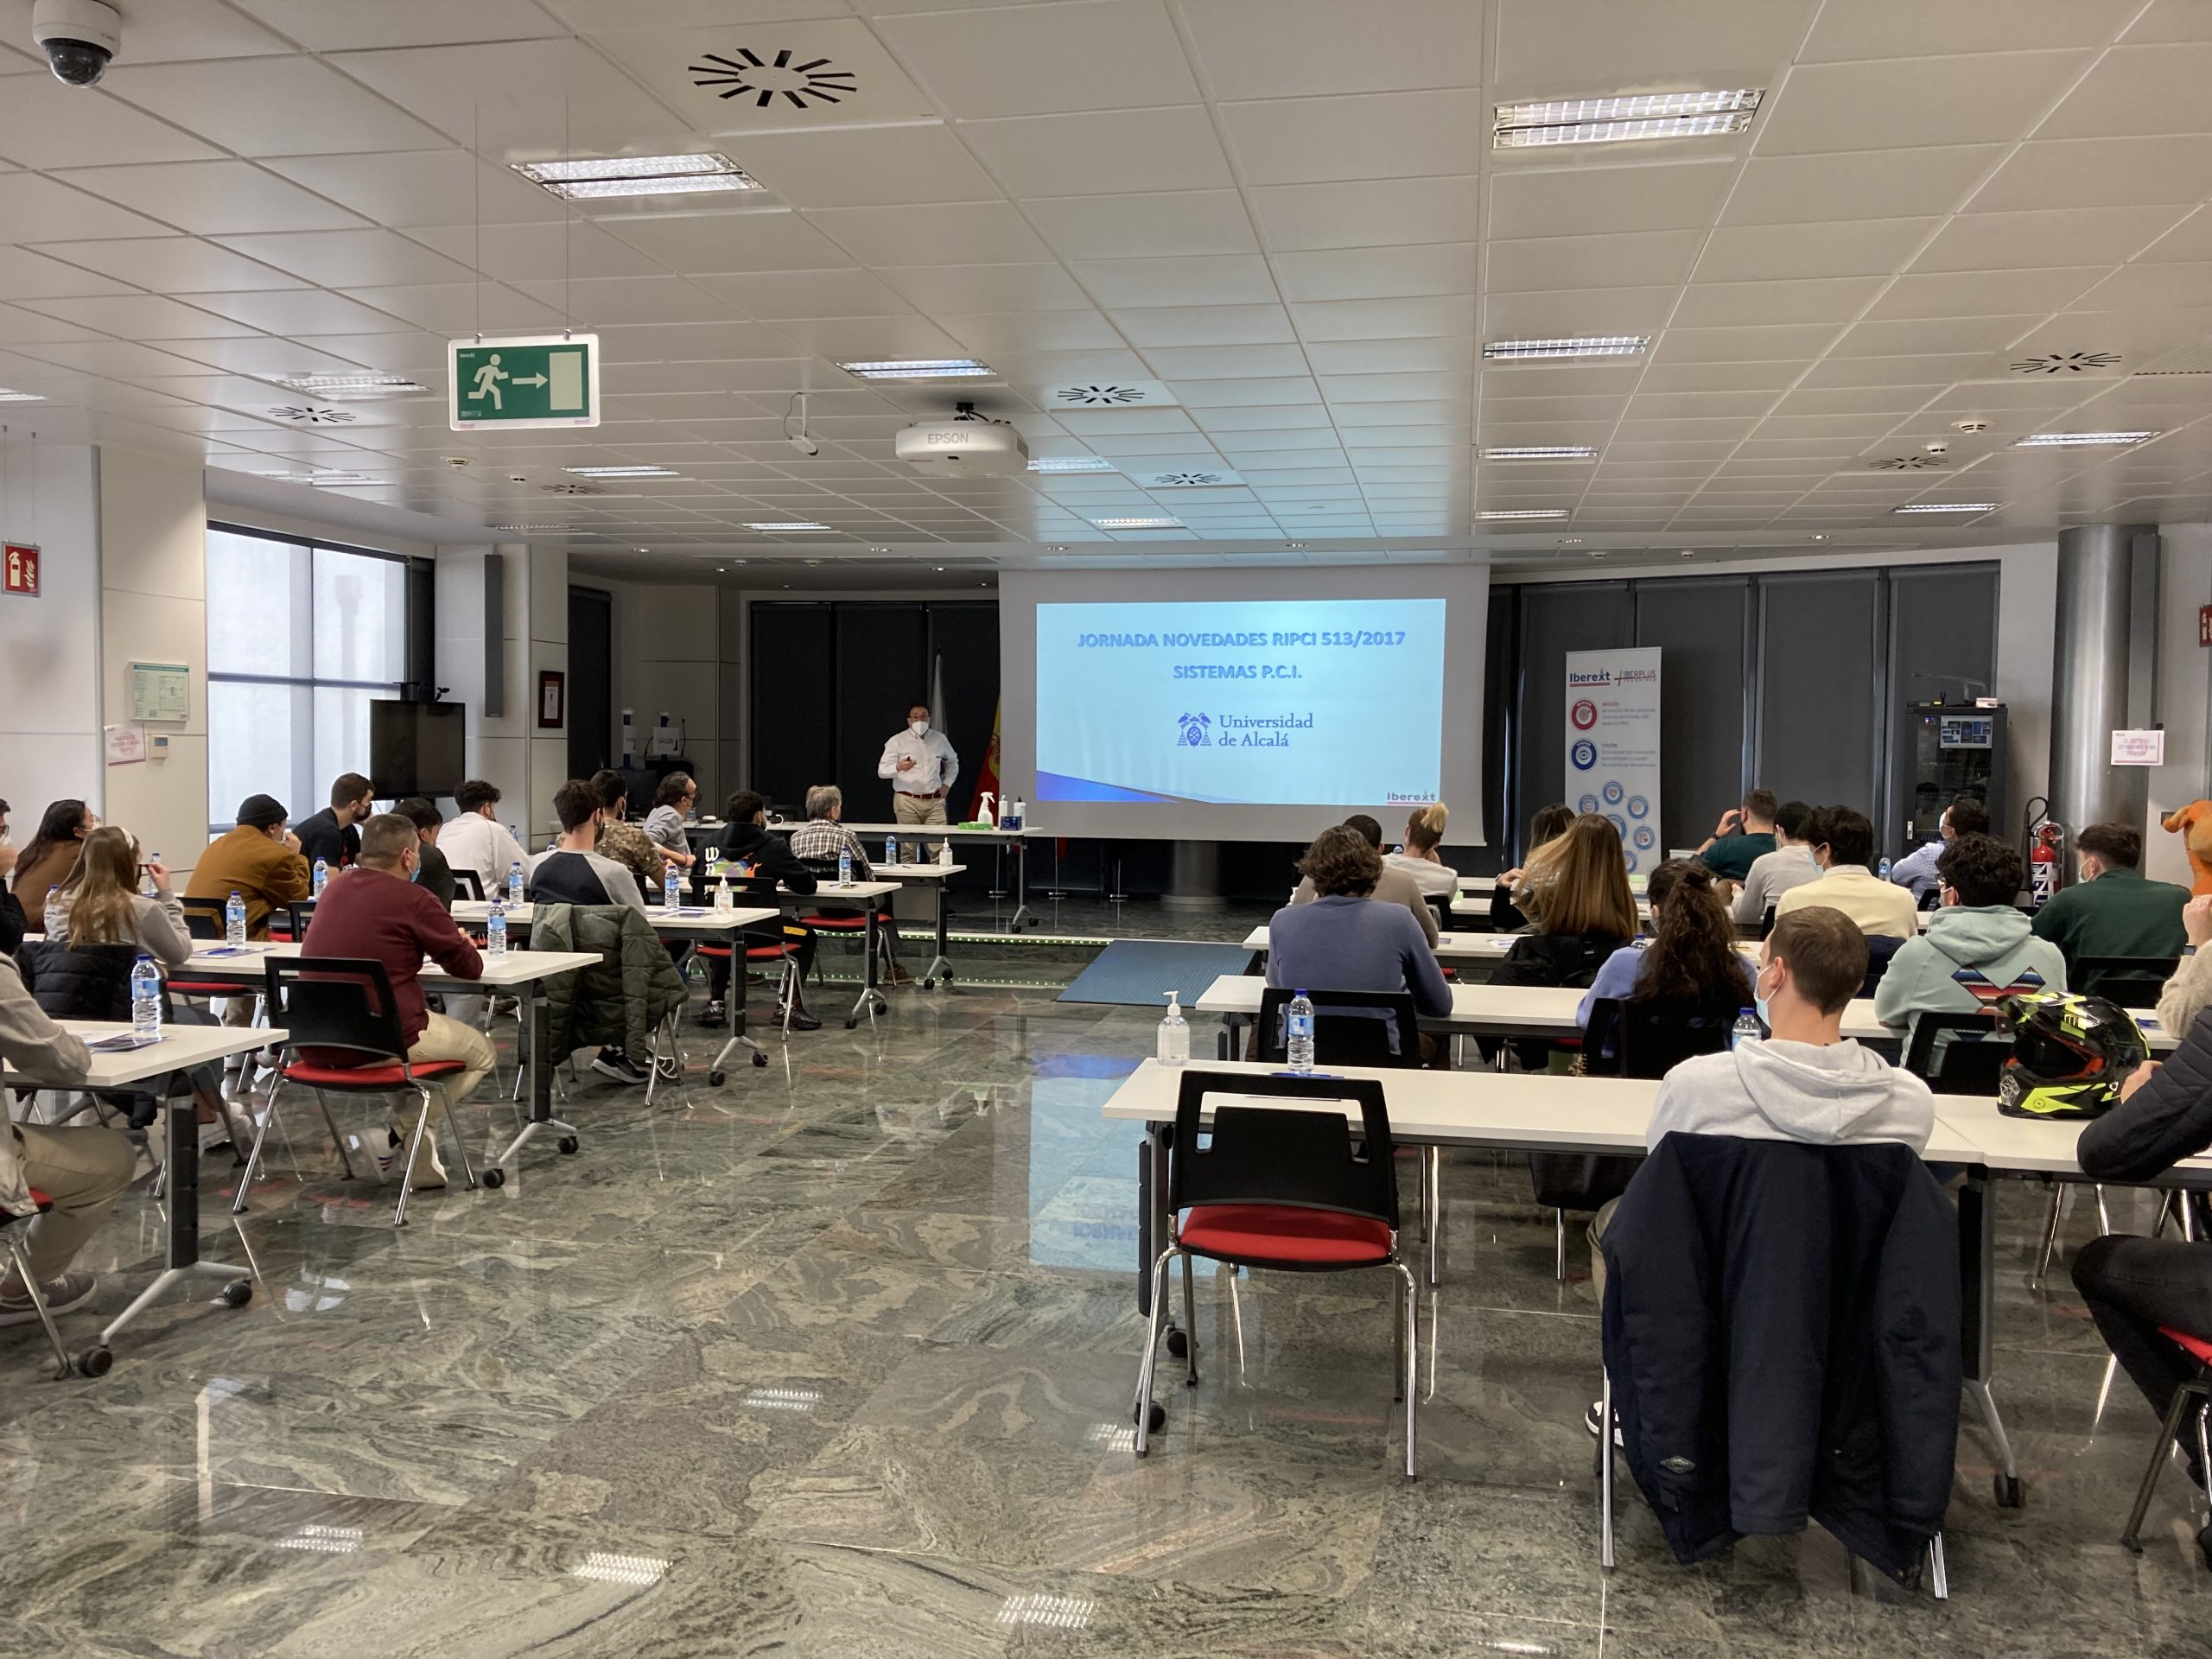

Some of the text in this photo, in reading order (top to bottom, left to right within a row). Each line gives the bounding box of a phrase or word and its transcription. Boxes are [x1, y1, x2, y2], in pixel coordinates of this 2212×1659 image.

[927, 433, 969, 444] EPSON
[1077, 630, 1407, 648] JORNADA NOVEDADES RIPCI 513/2017
[1173, 664, 1303, 680] SISTEMAS P.C.I.
[1569, 671, 1611, 683] Iberext
[1218, 712, 1313, 729] Universidad
[1218, 731, 1290, 747] de Alcalá
[1387, 791, 1435, 801] Iberext
